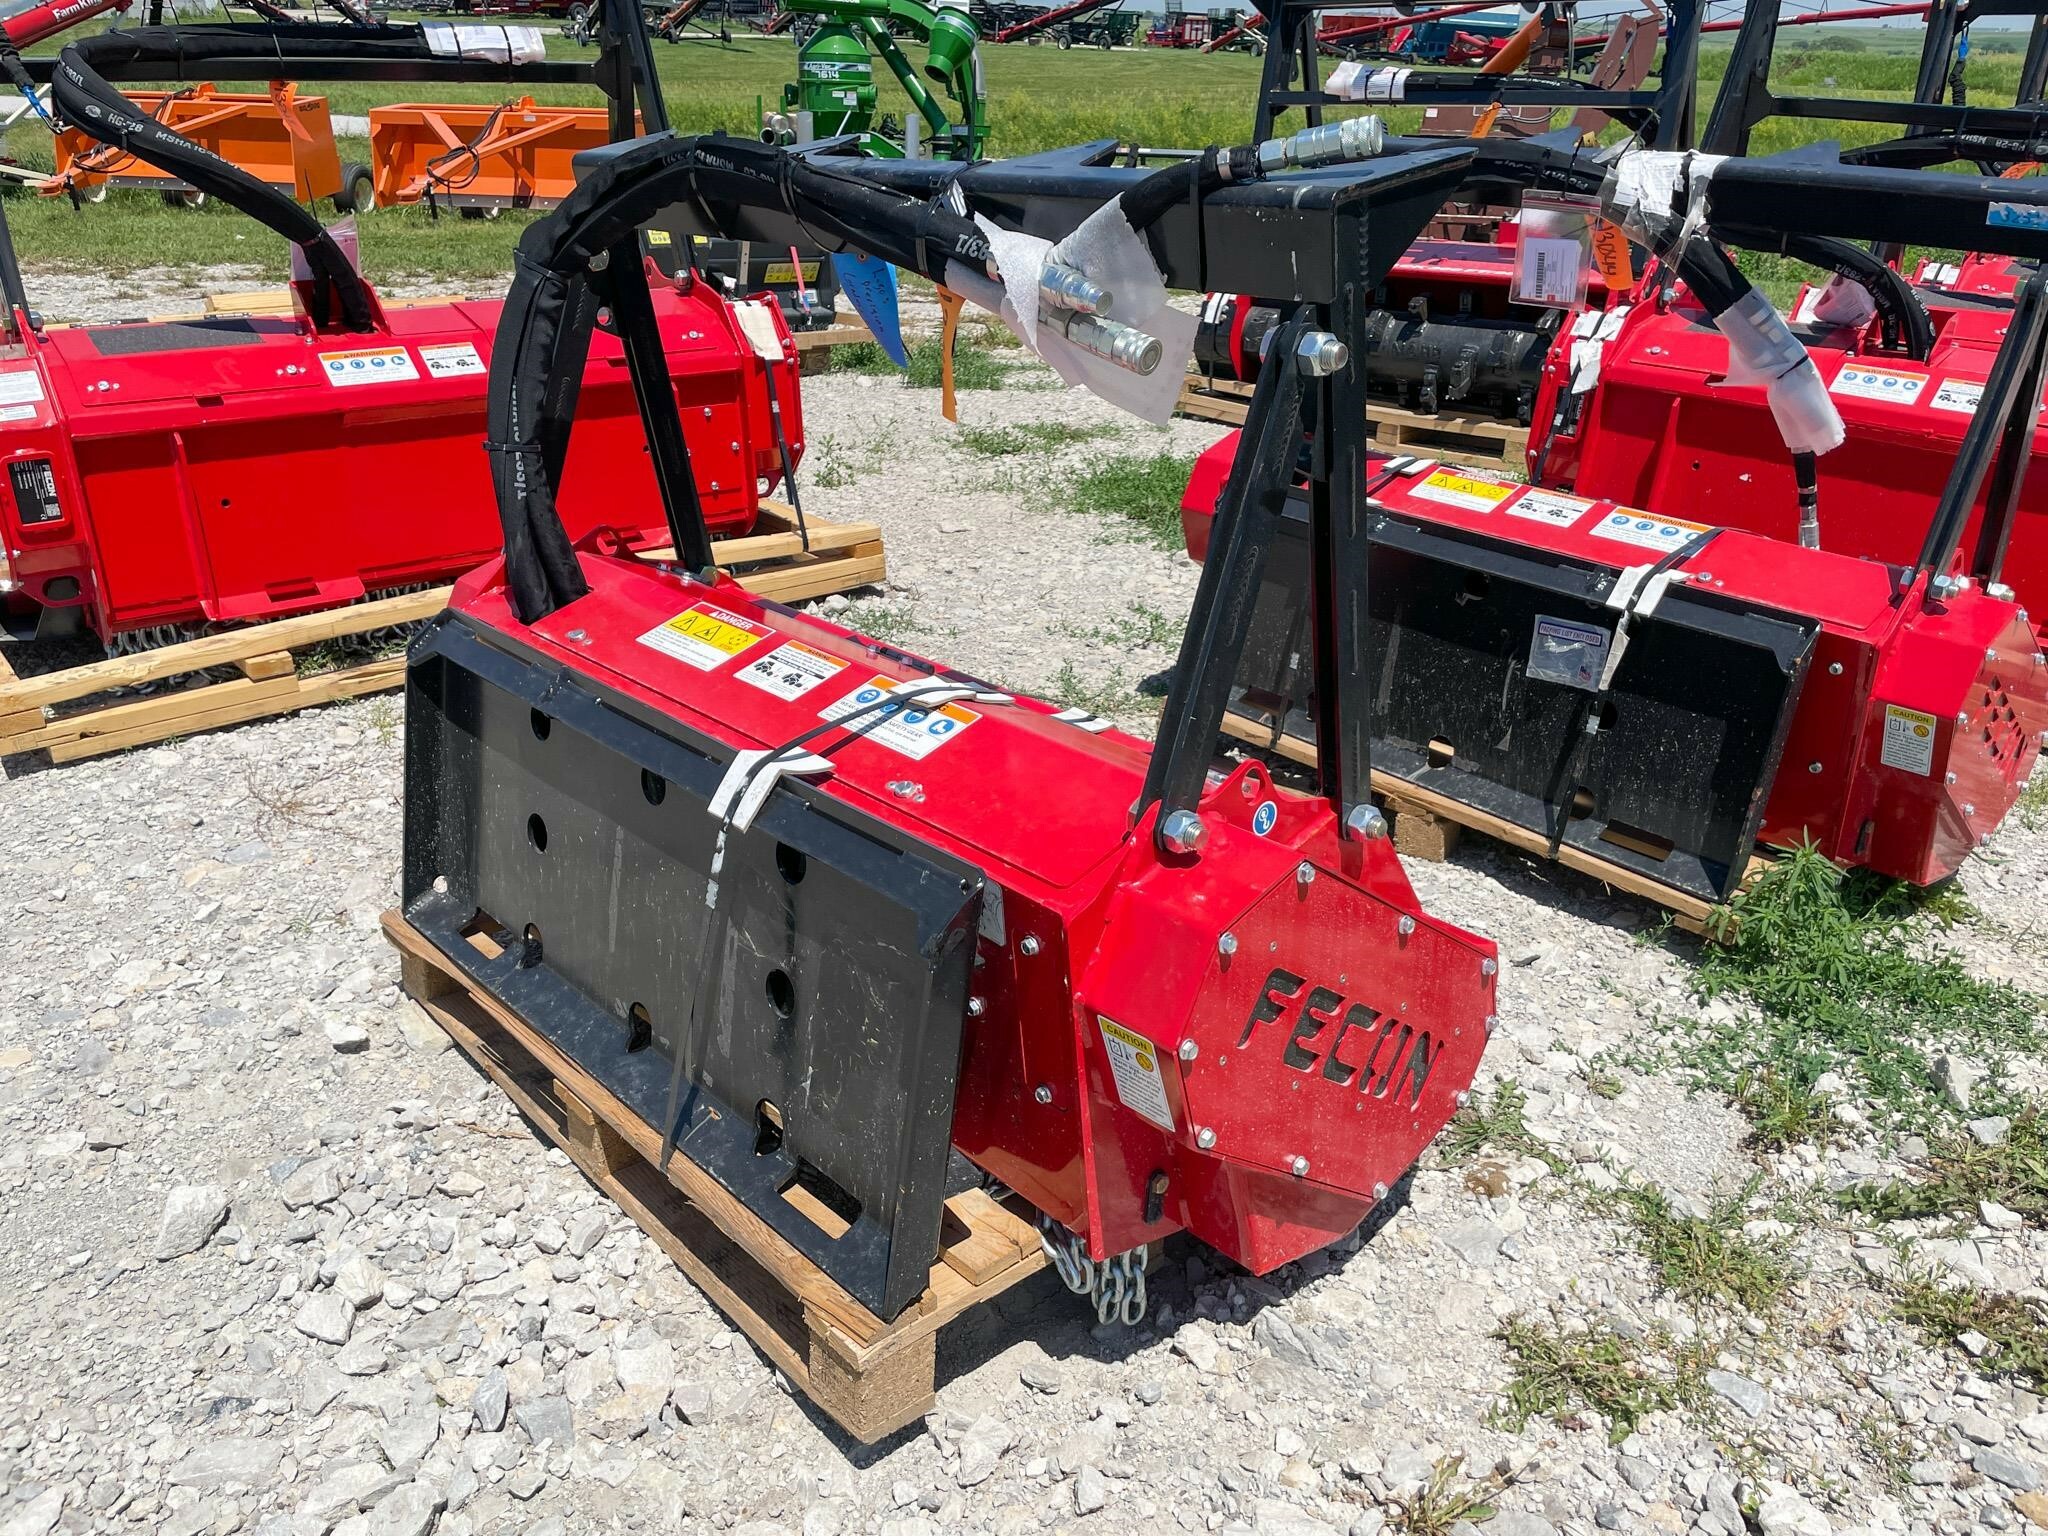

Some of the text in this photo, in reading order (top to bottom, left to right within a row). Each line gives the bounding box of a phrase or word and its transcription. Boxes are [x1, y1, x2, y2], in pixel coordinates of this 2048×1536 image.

[52, 4, 80, 22] Farm
[817, 70, 840, 79] 7614
[107, 112, 144, 133] HG-28
[155, 130, 191, 148] MSHA
[718, 611, 754, 631] DANGER
[1892, 709, 1930, 723] CAUTION
[1106, 1024, 1148, 1050] CAUTION
[1236, 967, 1446, 1112] FECON
